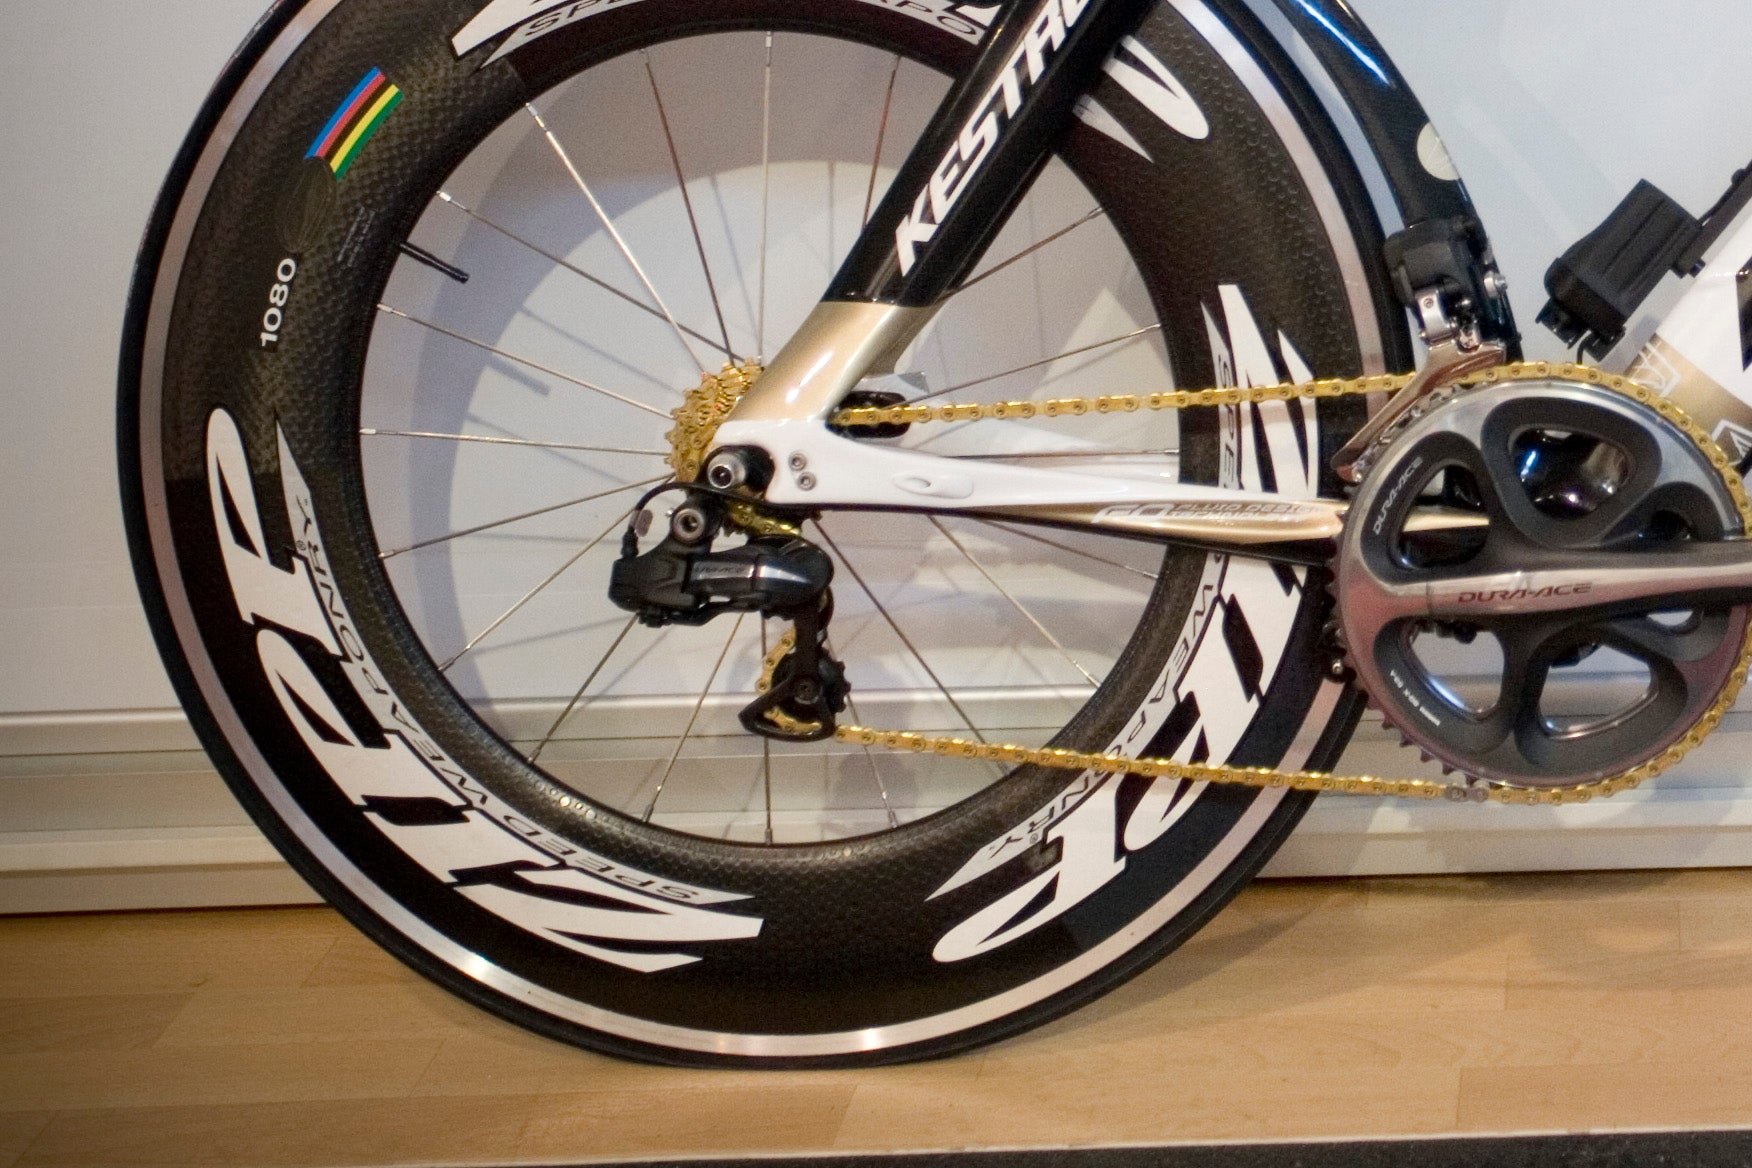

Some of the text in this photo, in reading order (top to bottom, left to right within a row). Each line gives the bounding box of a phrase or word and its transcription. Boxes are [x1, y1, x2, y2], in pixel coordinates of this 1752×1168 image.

[260, 257, 297, 347] 1080
[1372, 456, 1423, 534] DURA-ACE
[1457, 583, 1593, 603] DURA-ACE
[206, 407, 764, 973] ZIPP
[296, 496, 700, 903] SPEED WEAPONRY
